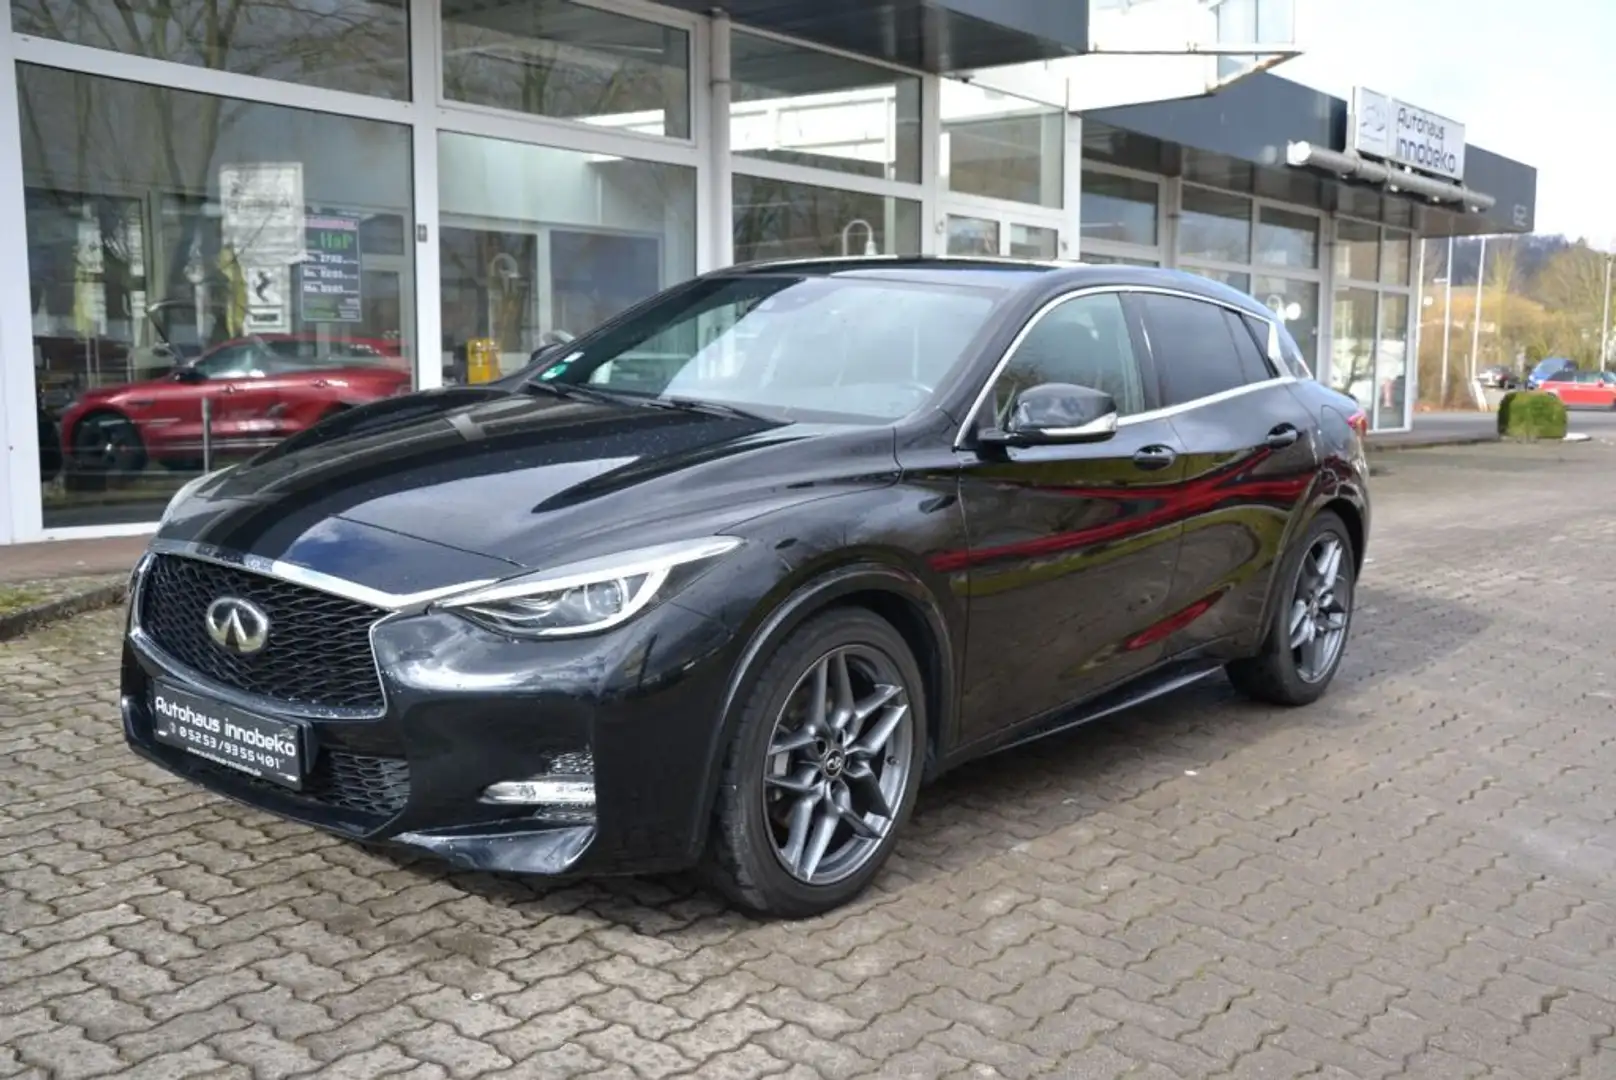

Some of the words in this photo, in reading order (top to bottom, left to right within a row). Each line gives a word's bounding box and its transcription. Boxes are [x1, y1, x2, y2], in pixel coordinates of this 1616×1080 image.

[1398, 107, 1445, 140] Autohaus
[1396, 129, 1456, 173] innobeko
[155, 696, 221, 733] Autohaus
[224, 717, 297, 757] innobeko
